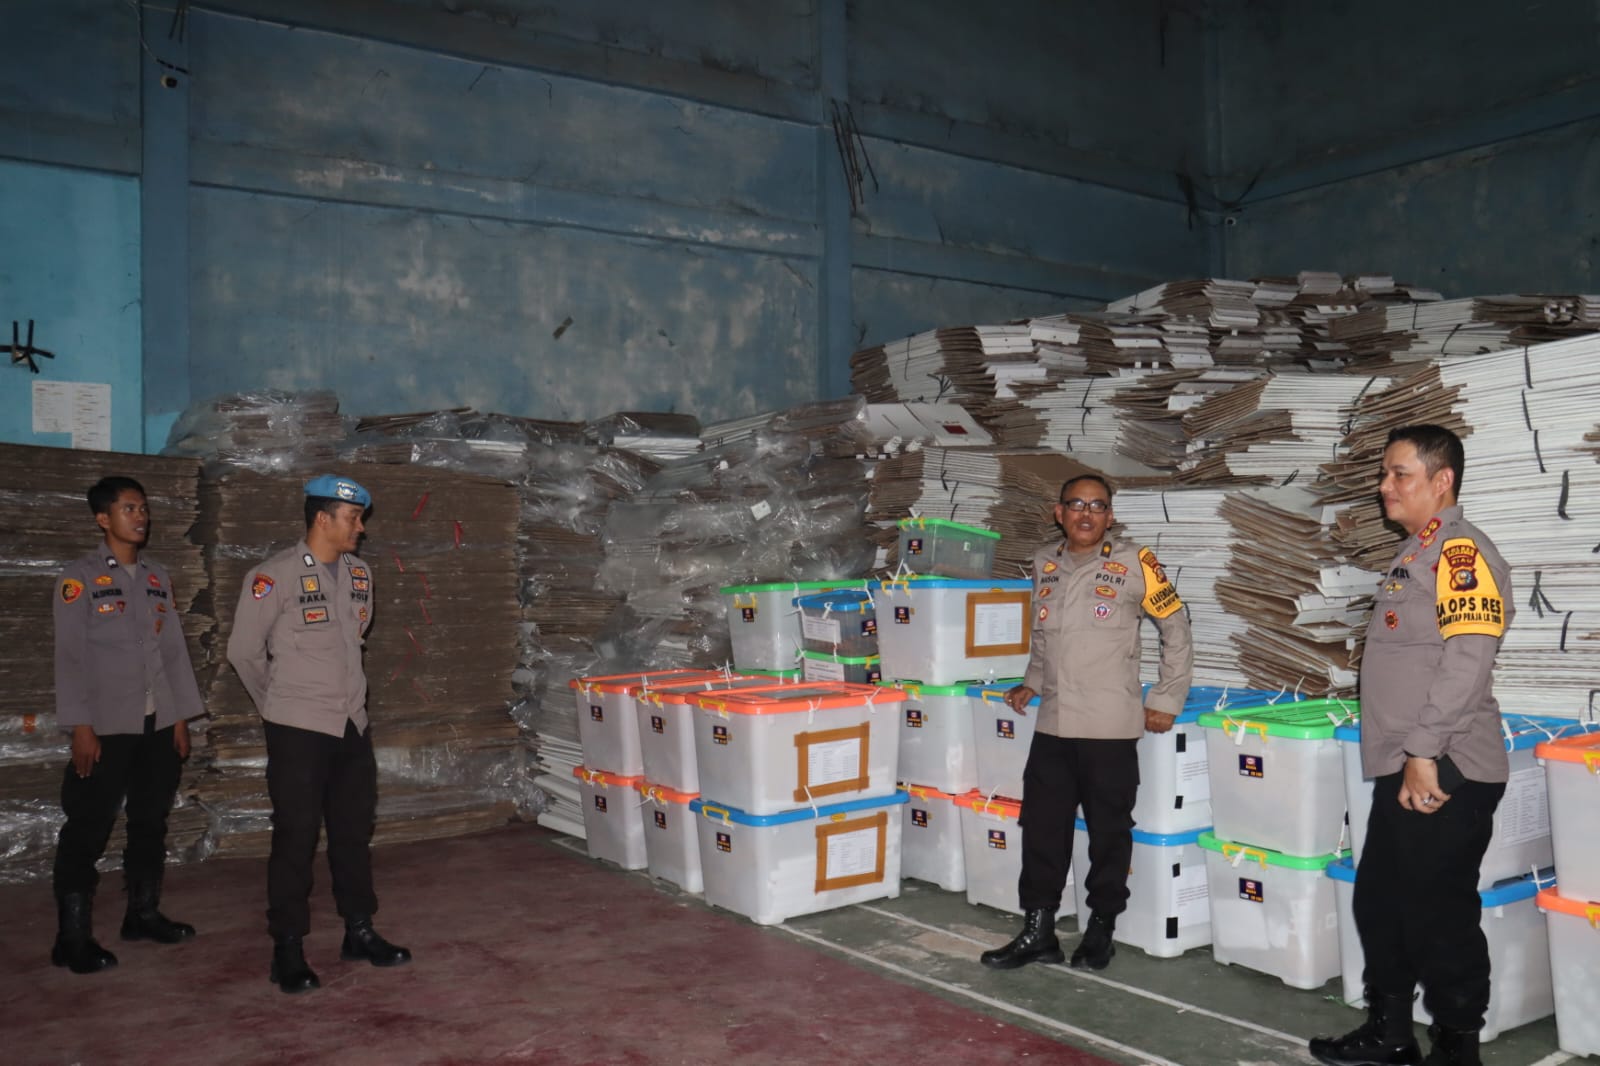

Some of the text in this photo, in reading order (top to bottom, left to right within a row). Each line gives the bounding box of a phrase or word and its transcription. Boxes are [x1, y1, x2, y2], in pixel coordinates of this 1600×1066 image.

[1095, 573, 1126, 586] POLRI
[299, 593, 327, 604] RAKA
[1448, 596, 1477, 613] OPS
[1481, 597, 1501, 615] RES
